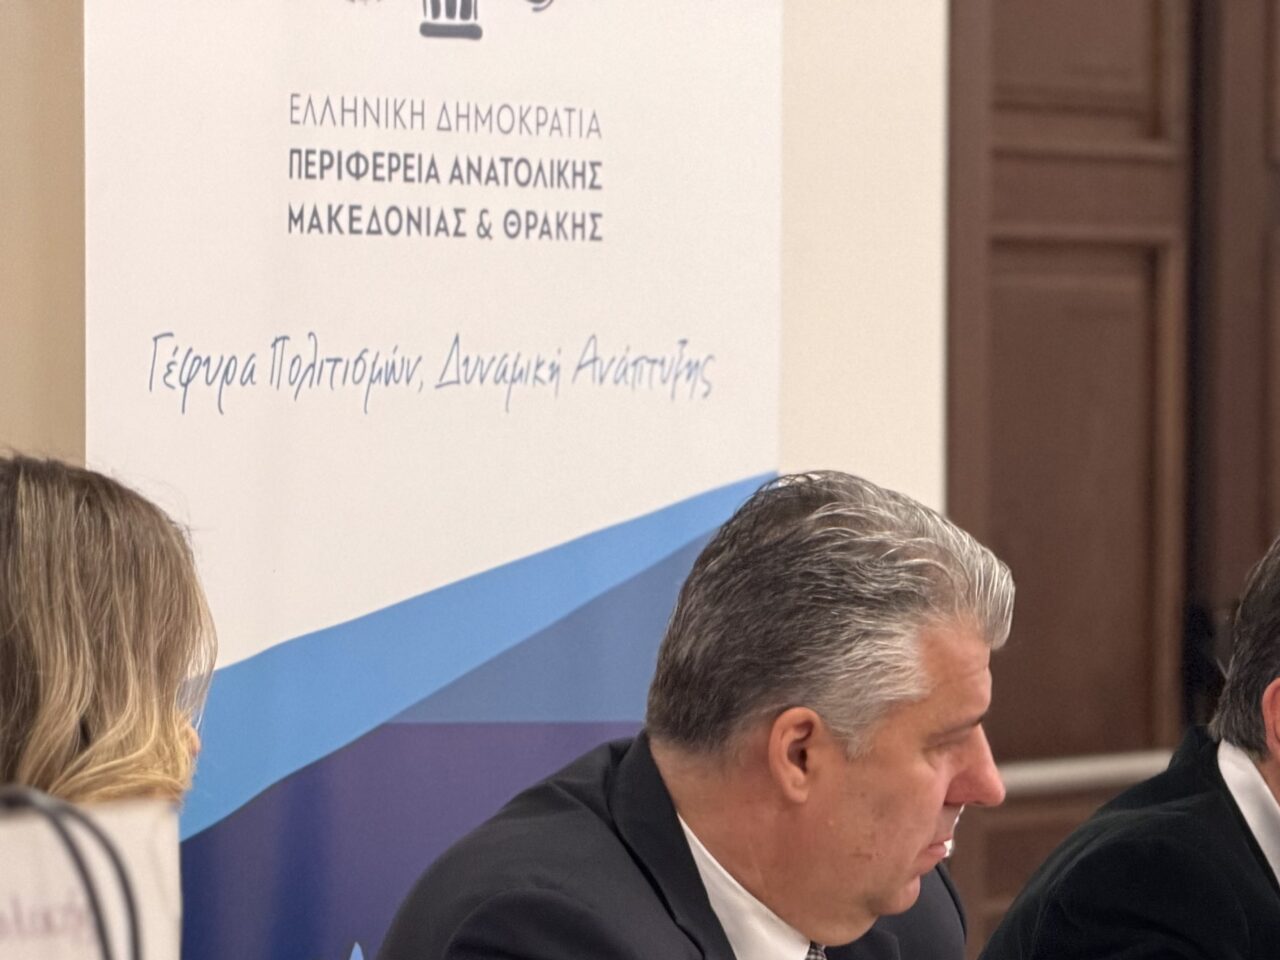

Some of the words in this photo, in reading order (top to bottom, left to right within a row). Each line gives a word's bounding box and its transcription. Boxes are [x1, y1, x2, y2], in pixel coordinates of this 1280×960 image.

[289, 93, 425, 131] ΕΛΛΗΝΙΚΗ
[435, 101, 602, 139] ΔΗΜΟΚΡΑΤΙΑ
[288, 148, 440, 185] ΠΕΡΙΦΕΡΕΙΑ
[448, 154, 603, 190] ΑΝΑΤΟΛΙΚΗΣ
[287, 203, 467, 238] ΜΑΚΕΔΟΝΙΑΣ
[476, 208, 493, 240] &
[503, 209, 604, 242] ΘΡΑΚΗΣ
[149, 332, 257, 415] Γέφυρα
[434, 333, 563, 414] Δυναμική
